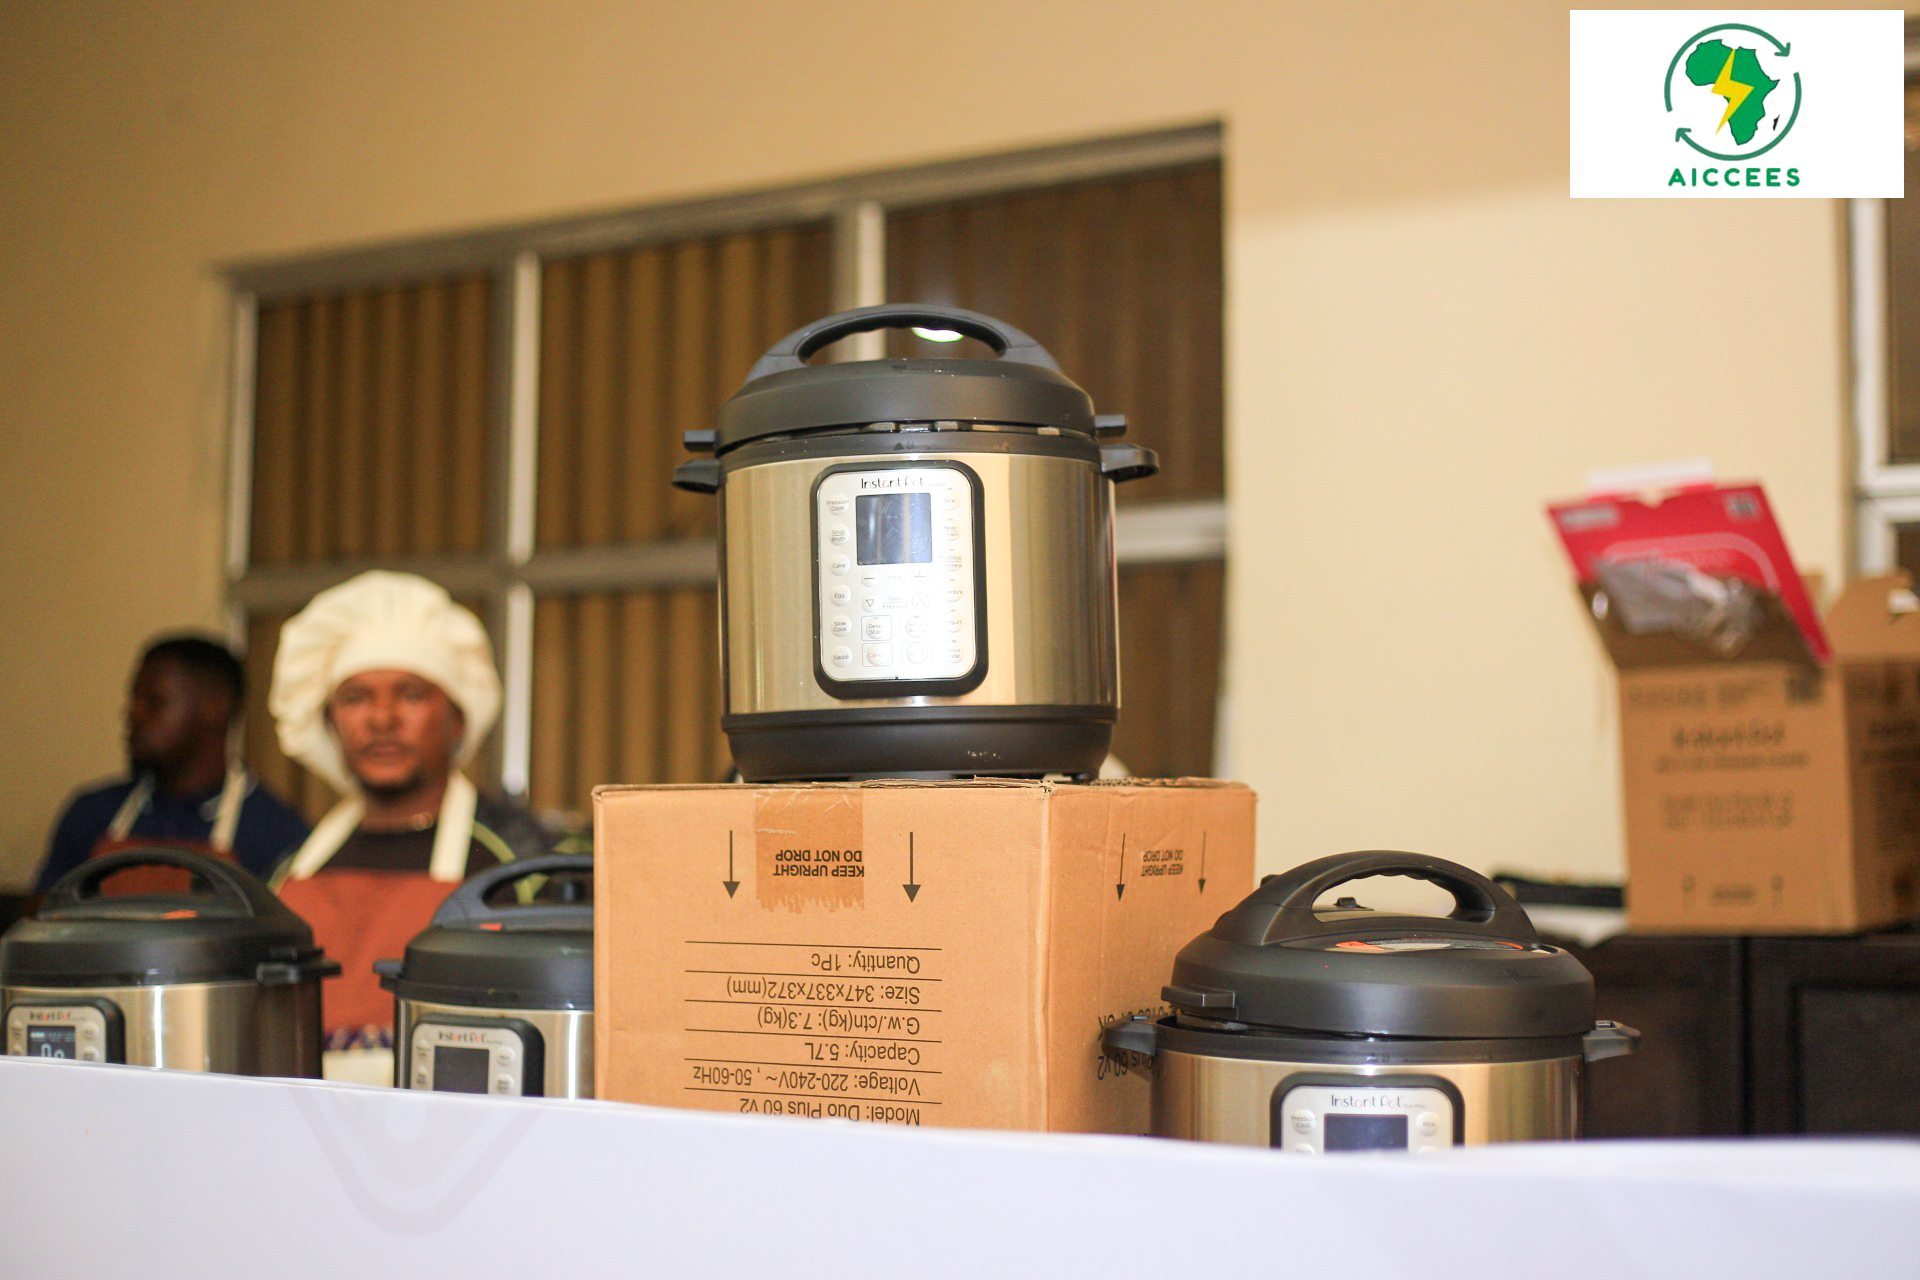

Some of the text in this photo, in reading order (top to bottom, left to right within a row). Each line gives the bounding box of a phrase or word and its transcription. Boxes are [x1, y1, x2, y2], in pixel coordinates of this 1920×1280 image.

[861, 476, 902, 489] Instant
[904, 476, 923, 488] Pot
[776, 850, 862, 862] DO NOT DROP
[1142, 850, 1184, 862] DO NOT DROP
[773, 864, 864, 877] KEEP UPRIGHT
[1141, 864, 1184, 877] KEEP UPRIGHT
[812, 950, 920, 974] Quantity: 1Pc
[726, 976, 920, 1005] Size: 347x337x372(mm)
[758, 1006, 920, 1035] G.w./ctn(kg): 7.3(kg)
[804, 1041, 920, 1066] Capacity: 5.7L
[693, 1066, 752, 1086] 50-60Hz
[854, 1072, 920, 1096] Voltage:
[1331, 1094, 1376, 1108] Instant
[1380, 1094, 1401, 1108] Pot
[740, 1097, 920, 1126] Model: Duo Plus 60 v2
